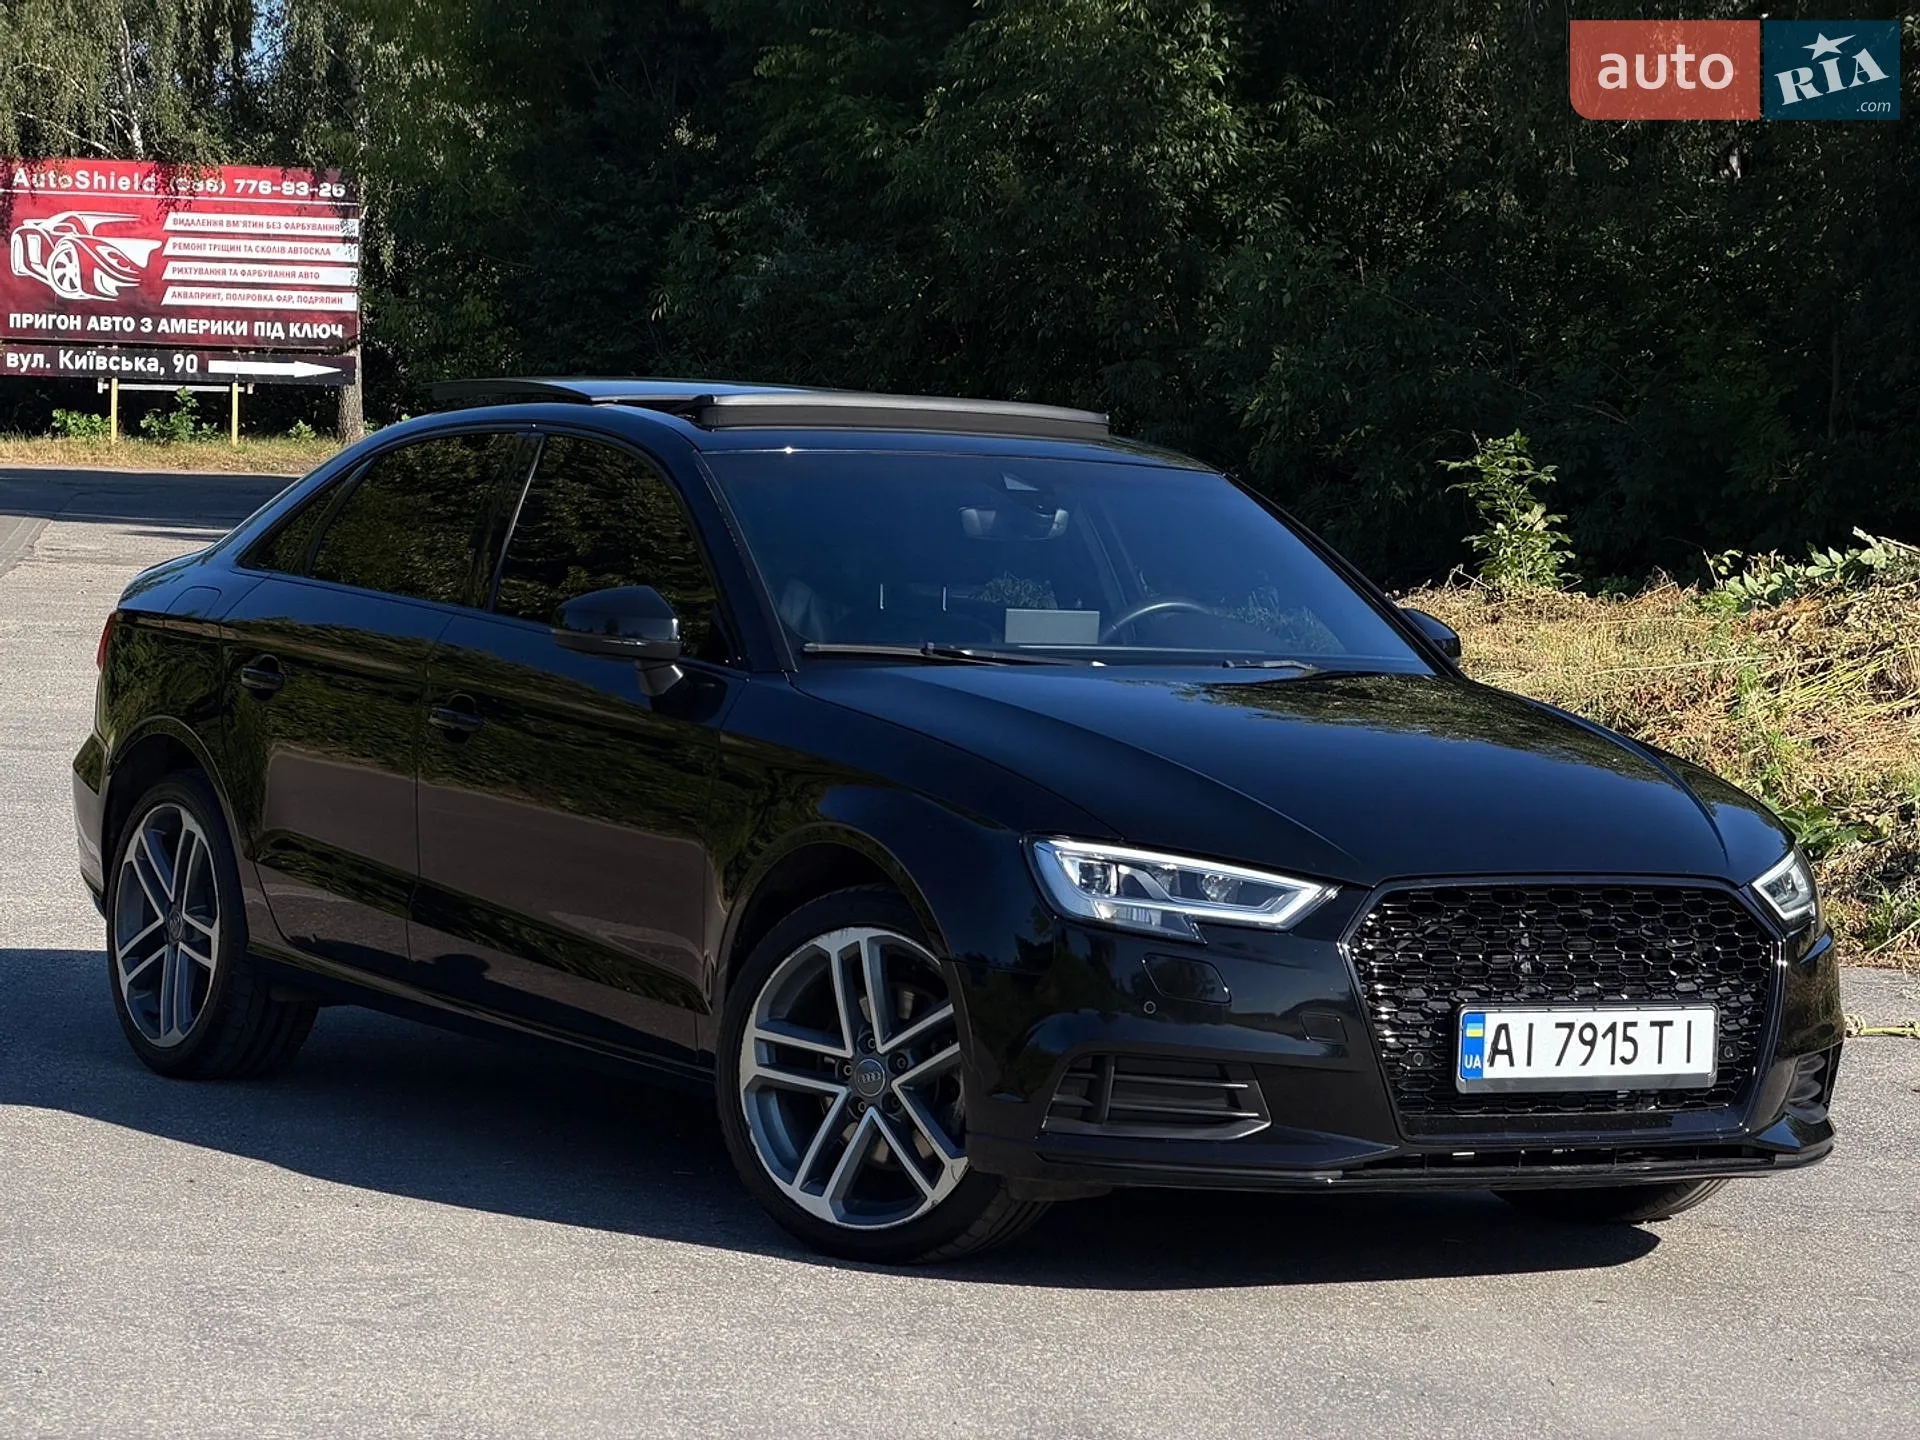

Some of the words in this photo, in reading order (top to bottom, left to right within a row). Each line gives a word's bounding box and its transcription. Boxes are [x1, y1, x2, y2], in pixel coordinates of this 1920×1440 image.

[13, 168, 156, 192] AutoShield
[233, 179, 346, 198] 776-93-26
[173, 217, 224, 228] ВИДАЛЕННЯ
[266, 221, 281, 230] БЕЗ
[284, 222, 340, 232] ФАРБУВАННЯ
[172, 242, 207, 252] РЕМОНТ
[209, 243, 242, 253] ТРІЩИН
[244, 244, 253, 253] ТА
[255, 245, 286, 254] СКОЛІВ
[287, 246, 332, 256] АВТОСКЛА
[172, 266, 227, 277] РИХТУВАННЯ
[229, 268, 238, 276] ТА
[240, 269, 297, 279] ФАРБУВАННЯ
[298, 271, 320, 280] АВТО
[171, 291, 223, 301] АКВАПРИНТ,
[226, 292, 274, 302] ПОЛІРОВКА
[276, 294, 295, 304] ФАР,
[9, 313, 82, 330] ПРИГОН
[87, 315, 136, 332] АВТО
[157, 318, 248, 337] АМЕРИКИ
[253, 321, 285, 340] ПІД
[289, 322, 344, 339] КЛЮЧ
[6, 352, 51, 373] вул.
[58, 350, 165, 375] Київська,
[173, 353, 198, 373] 90
[1487, 1022, 1534, 1067] AI
[1554, 1021, 1638, 1066] 7915
[1649, 1020, 1692, 1064] TI
[1464, 1055, 1482, 1069] UA
